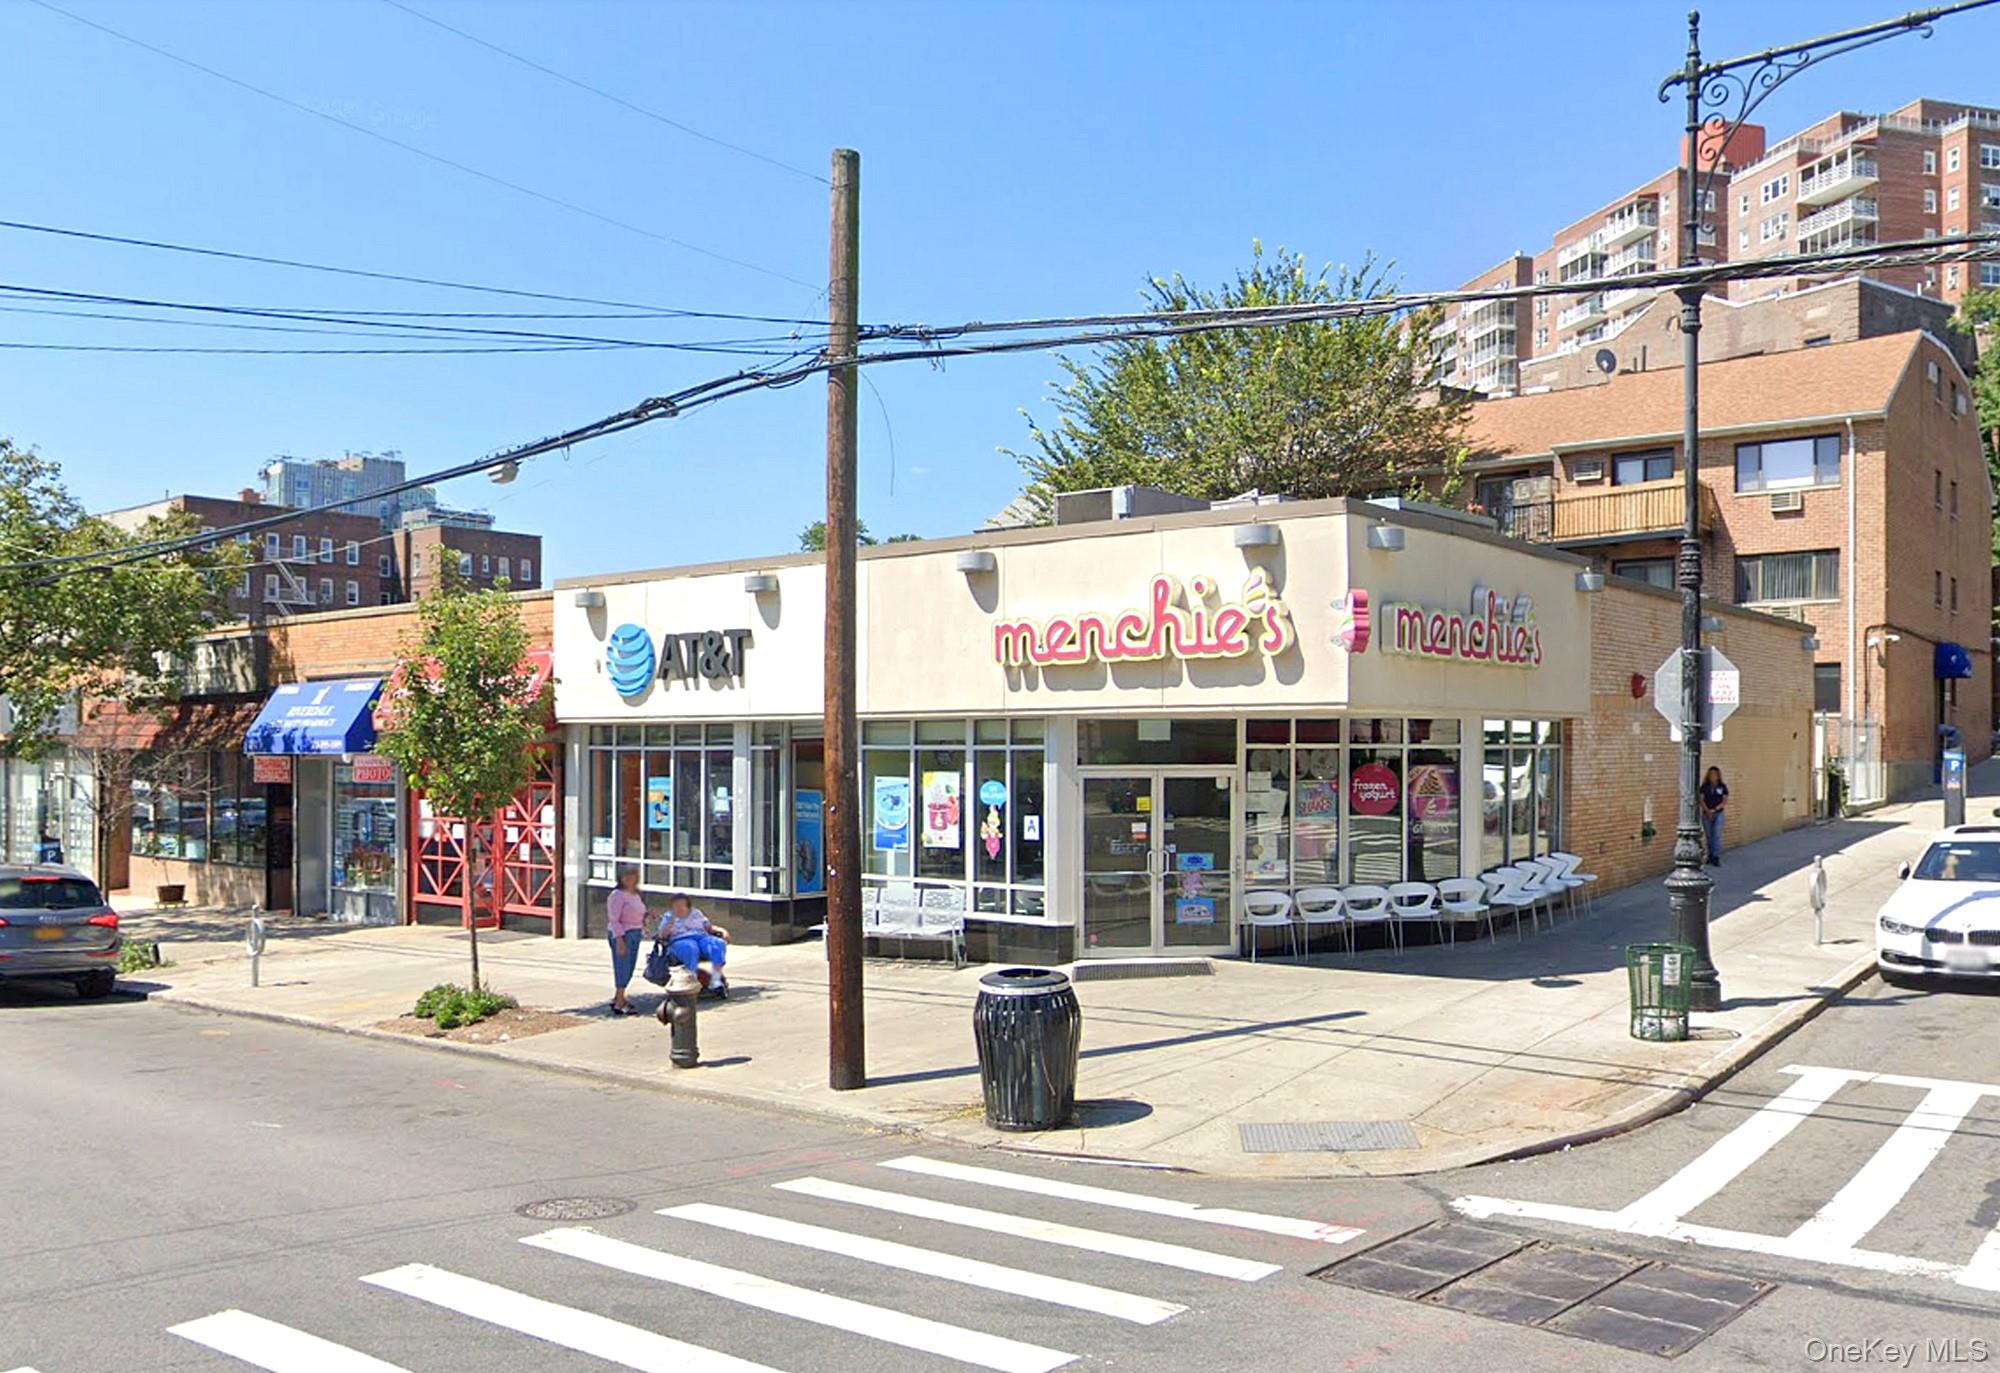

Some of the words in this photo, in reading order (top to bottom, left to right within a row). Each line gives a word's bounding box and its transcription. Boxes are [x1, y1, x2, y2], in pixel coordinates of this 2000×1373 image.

[992, 567, 1285, 664] menchie's
[656, 628, 752, 680] AT&T
[1352, 778, 1388, 793] frozen
[1360, 788, 1396, 802] yogurt
